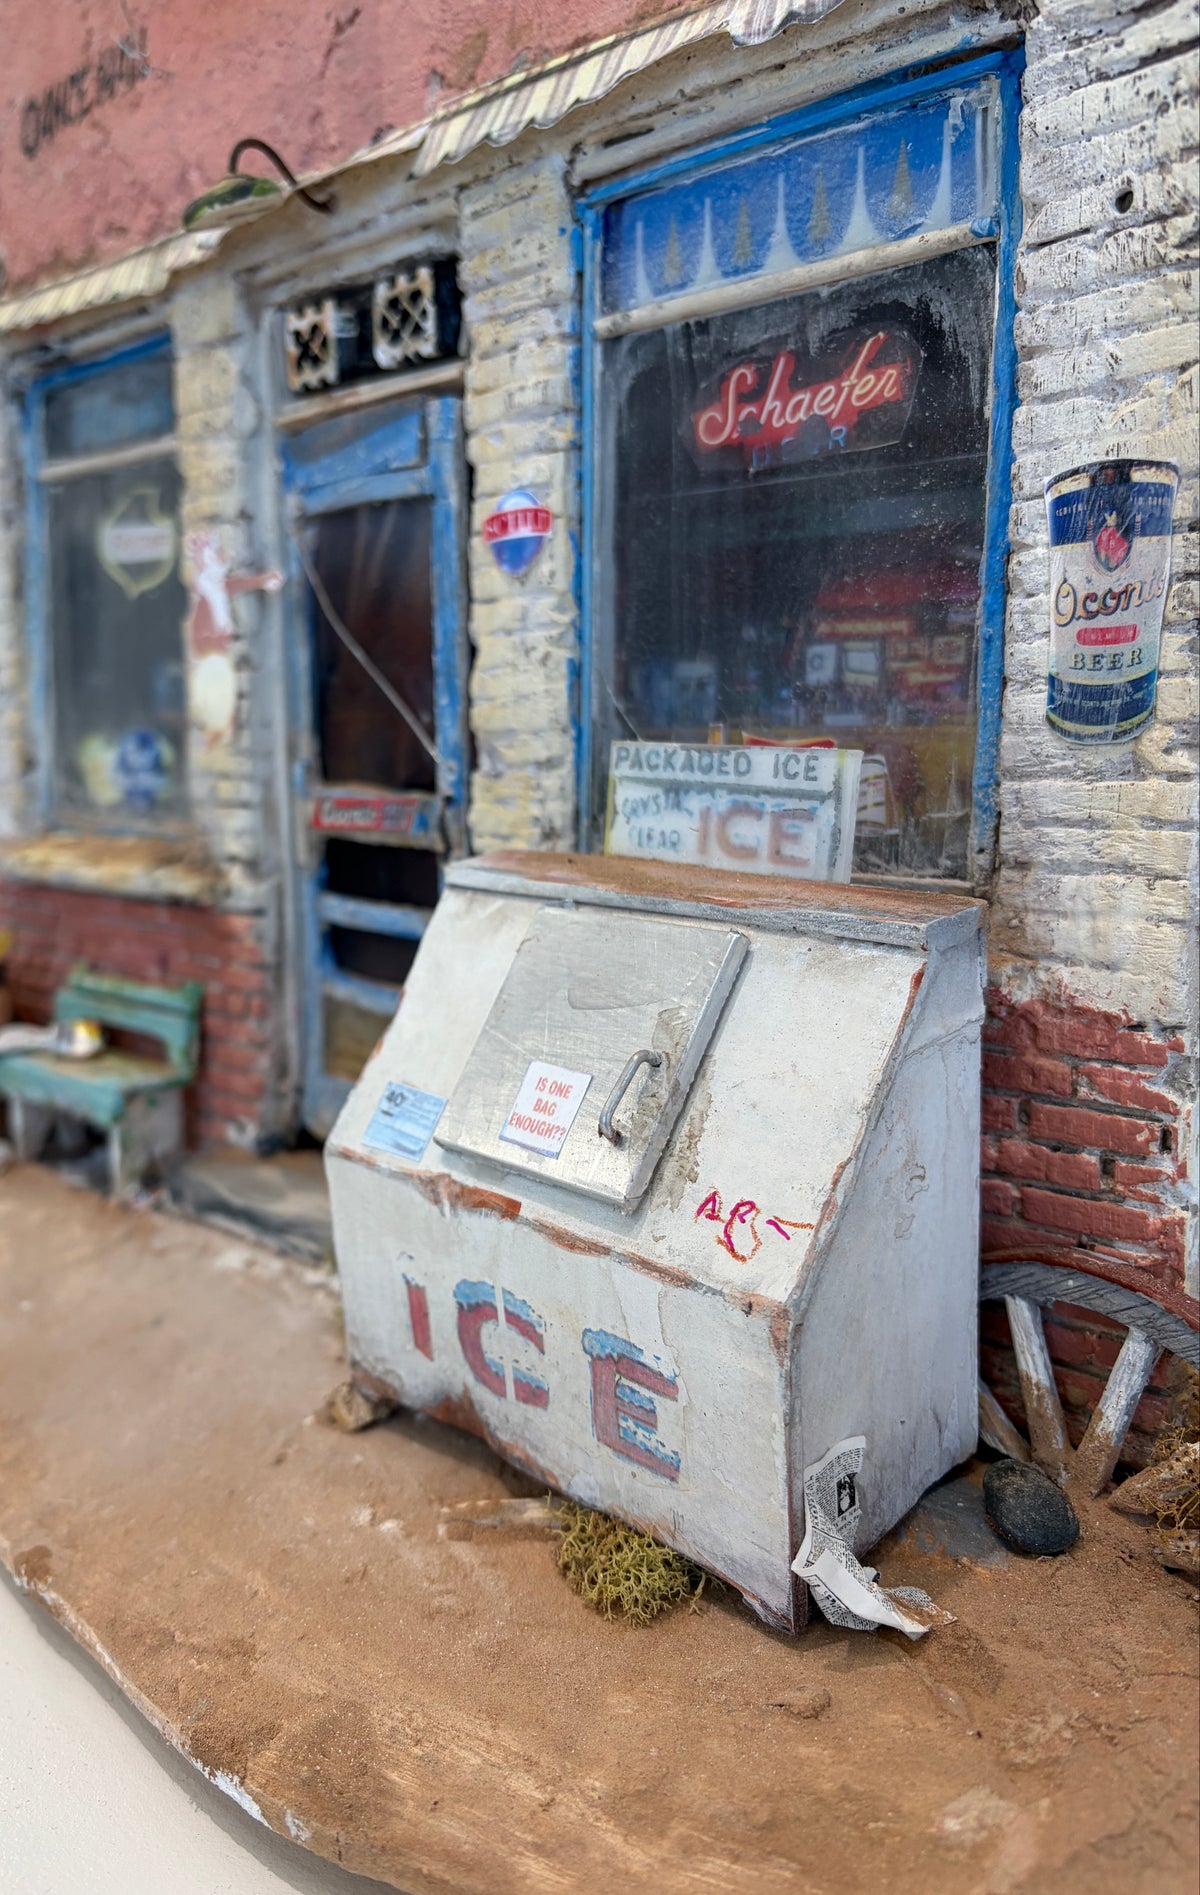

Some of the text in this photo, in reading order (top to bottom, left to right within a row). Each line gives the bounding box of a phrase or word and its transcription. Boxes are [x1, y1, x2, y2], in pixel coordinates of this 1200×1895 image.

[698, 331, 897, 445] Schaefer
[752, 425, 847, 467] BER
[1069, 648, 1144, 671] BEER
[772, 753, 819, 782] ICE
[695, 799, 819, 868] ICE
[535, 1076, 573, 1099] IS ONE
[532, 1098, 557, 1117] BAG
[508, 1111, 566, 1141] ENOUGH??
[400, 1273, 681, 1484] ICE
